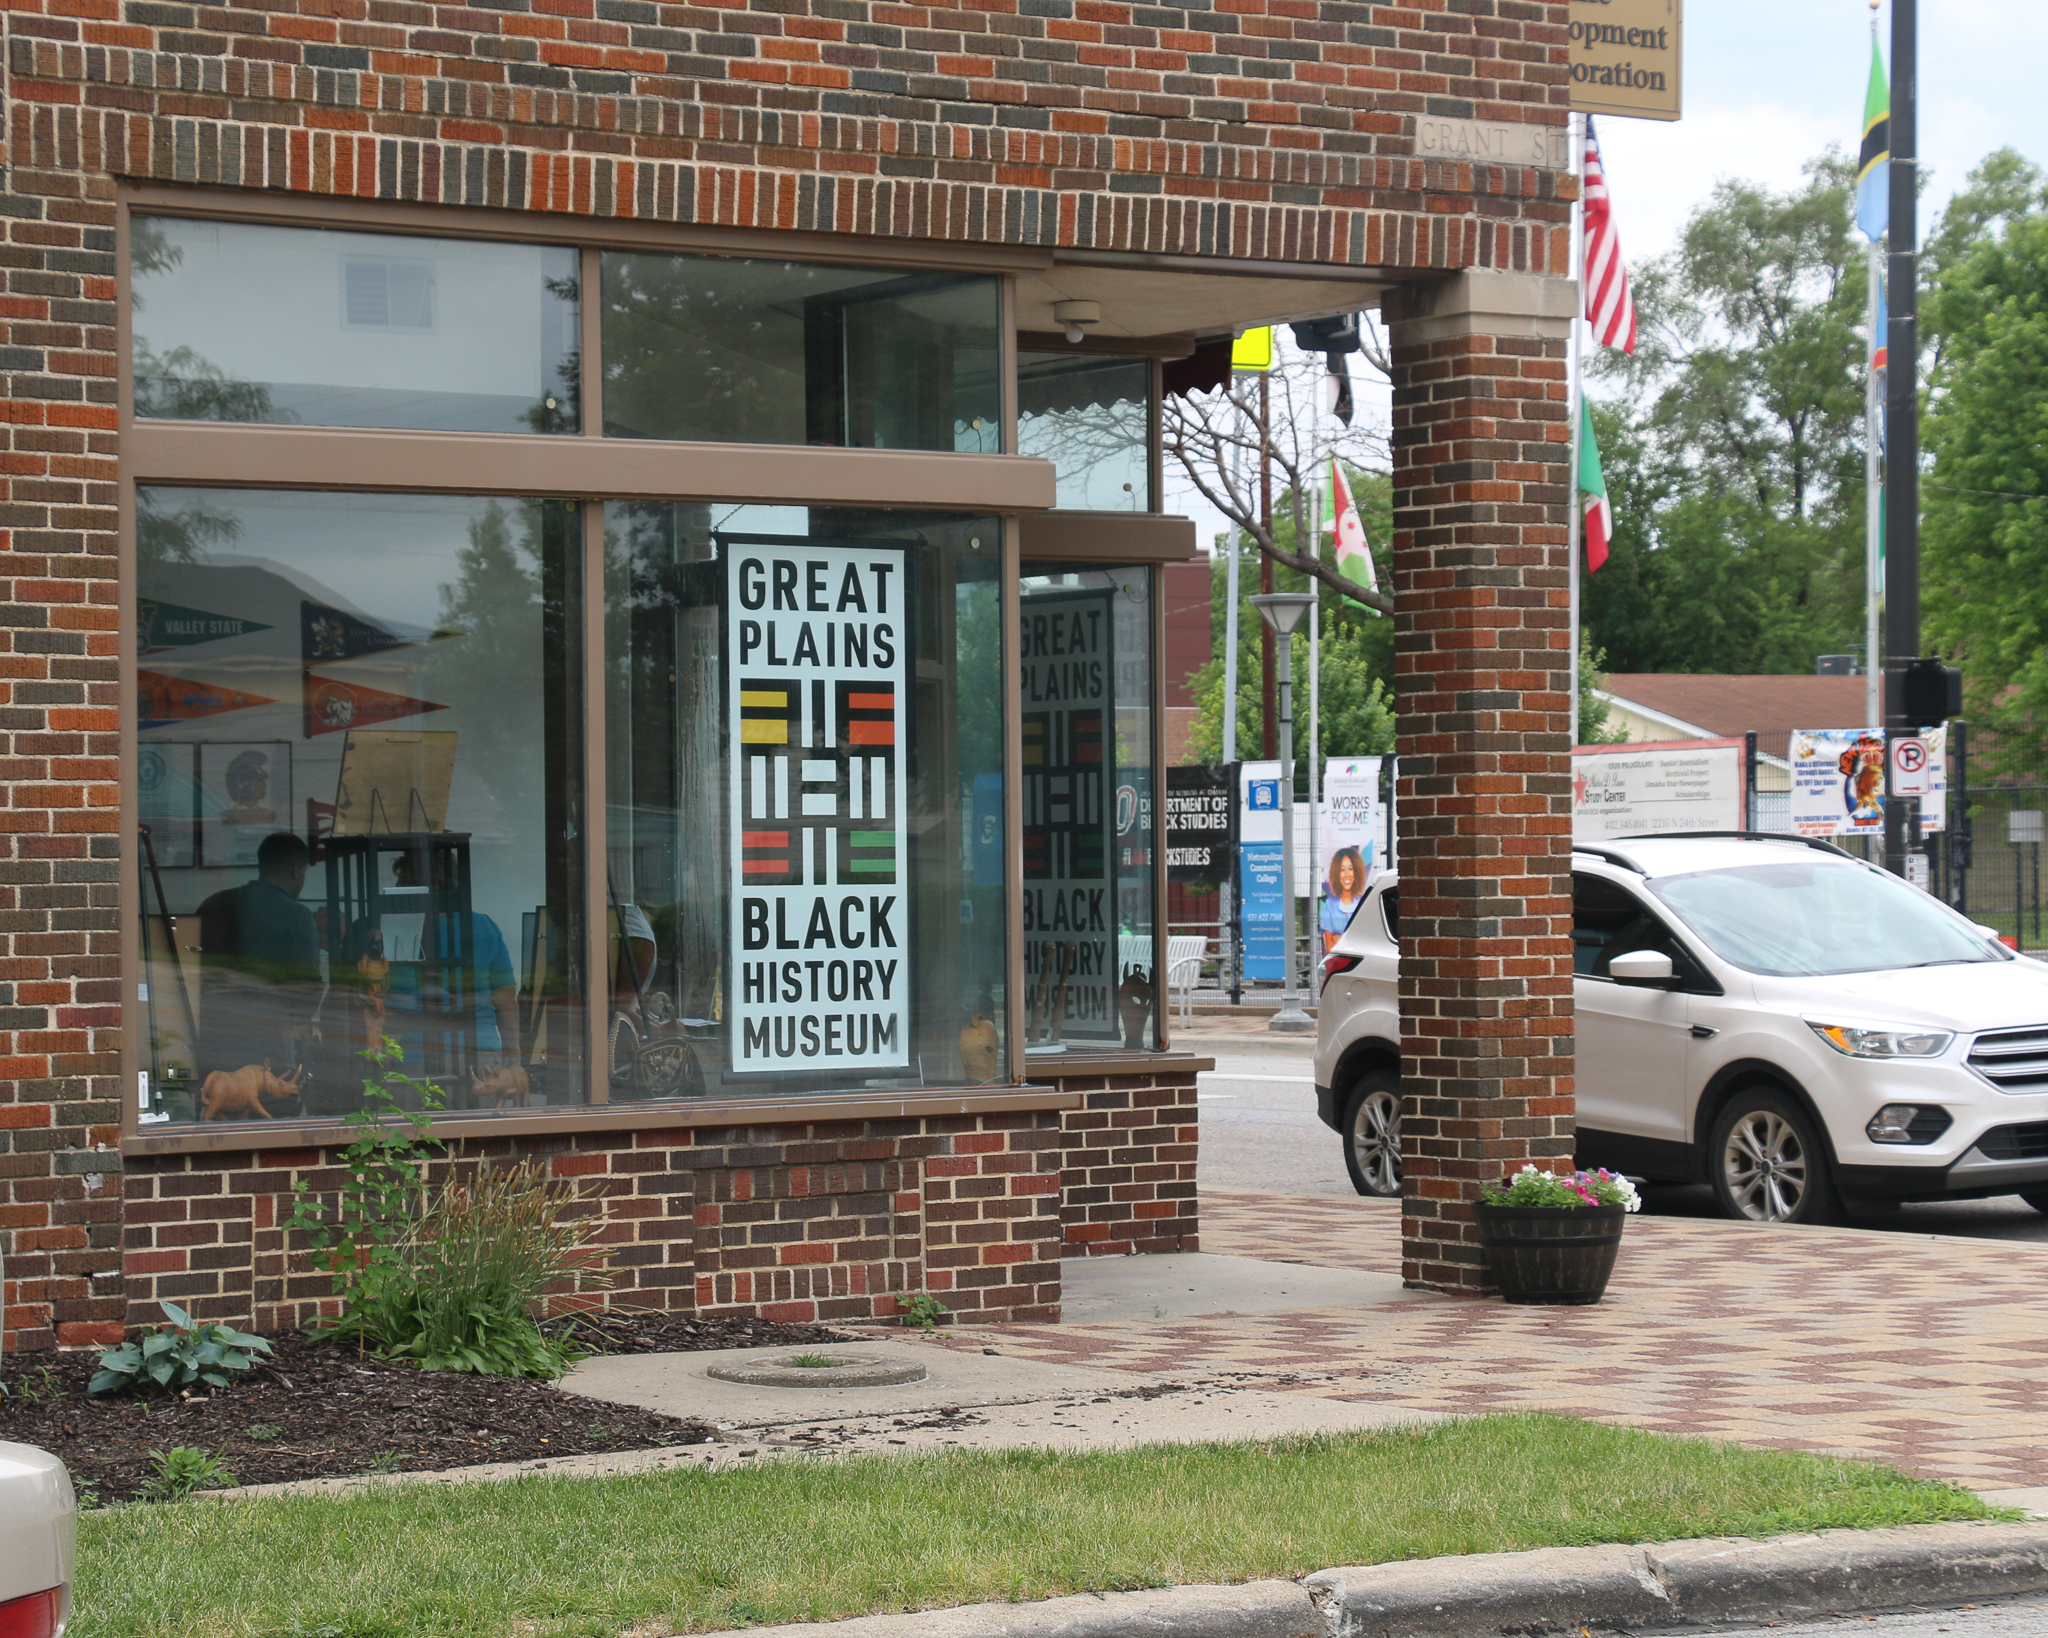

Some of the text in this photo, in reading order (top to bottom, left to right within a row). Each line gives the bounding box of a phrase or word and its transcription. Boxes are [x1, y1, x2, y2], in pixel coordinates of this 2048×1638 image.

[1421, 122, 1508, 157] GRANT
[739, 557, 894, 614] GREAT
[165, 620, 244, 634] VALLEY STATE
[1020, 609, 1102, 658] GREAT
[739, 619, 895, 669] PLAINS
[1608, 762, 1621, 770] OUR
[1678, 758, 1710, 767] Journalism
[1690, 769, 1710, 778] Project
[1646, 780, 1667, 788] Omaha
[1679, 779, 1710, 788] Newspaper
[1675, 791, 1710, 799] Scholarships
[1212, 797, 1228, 812] OF
[1332, 796, 1370, 810] WORKS
[1331, 811, 1369, 825] FOR ME
[1600, 807, 1633, 816] organization
[1180, 813, 1228, 830] STUDIES
[1652, 818, 1670, 829] 2216
[1680, 818, 1696, 827] 24th
[1697, 817, 1719, 827] Street
[1250, 863, 1283, 873] Community
[1256, 874, 1278, 884] College
[1023, 888, 1106, 932] BLACK
[742, 895, 898, 950] BLACK
[743, 959, 898, 1004] HISTORY
[743, 1012, 898, 1059] MUSEUM
